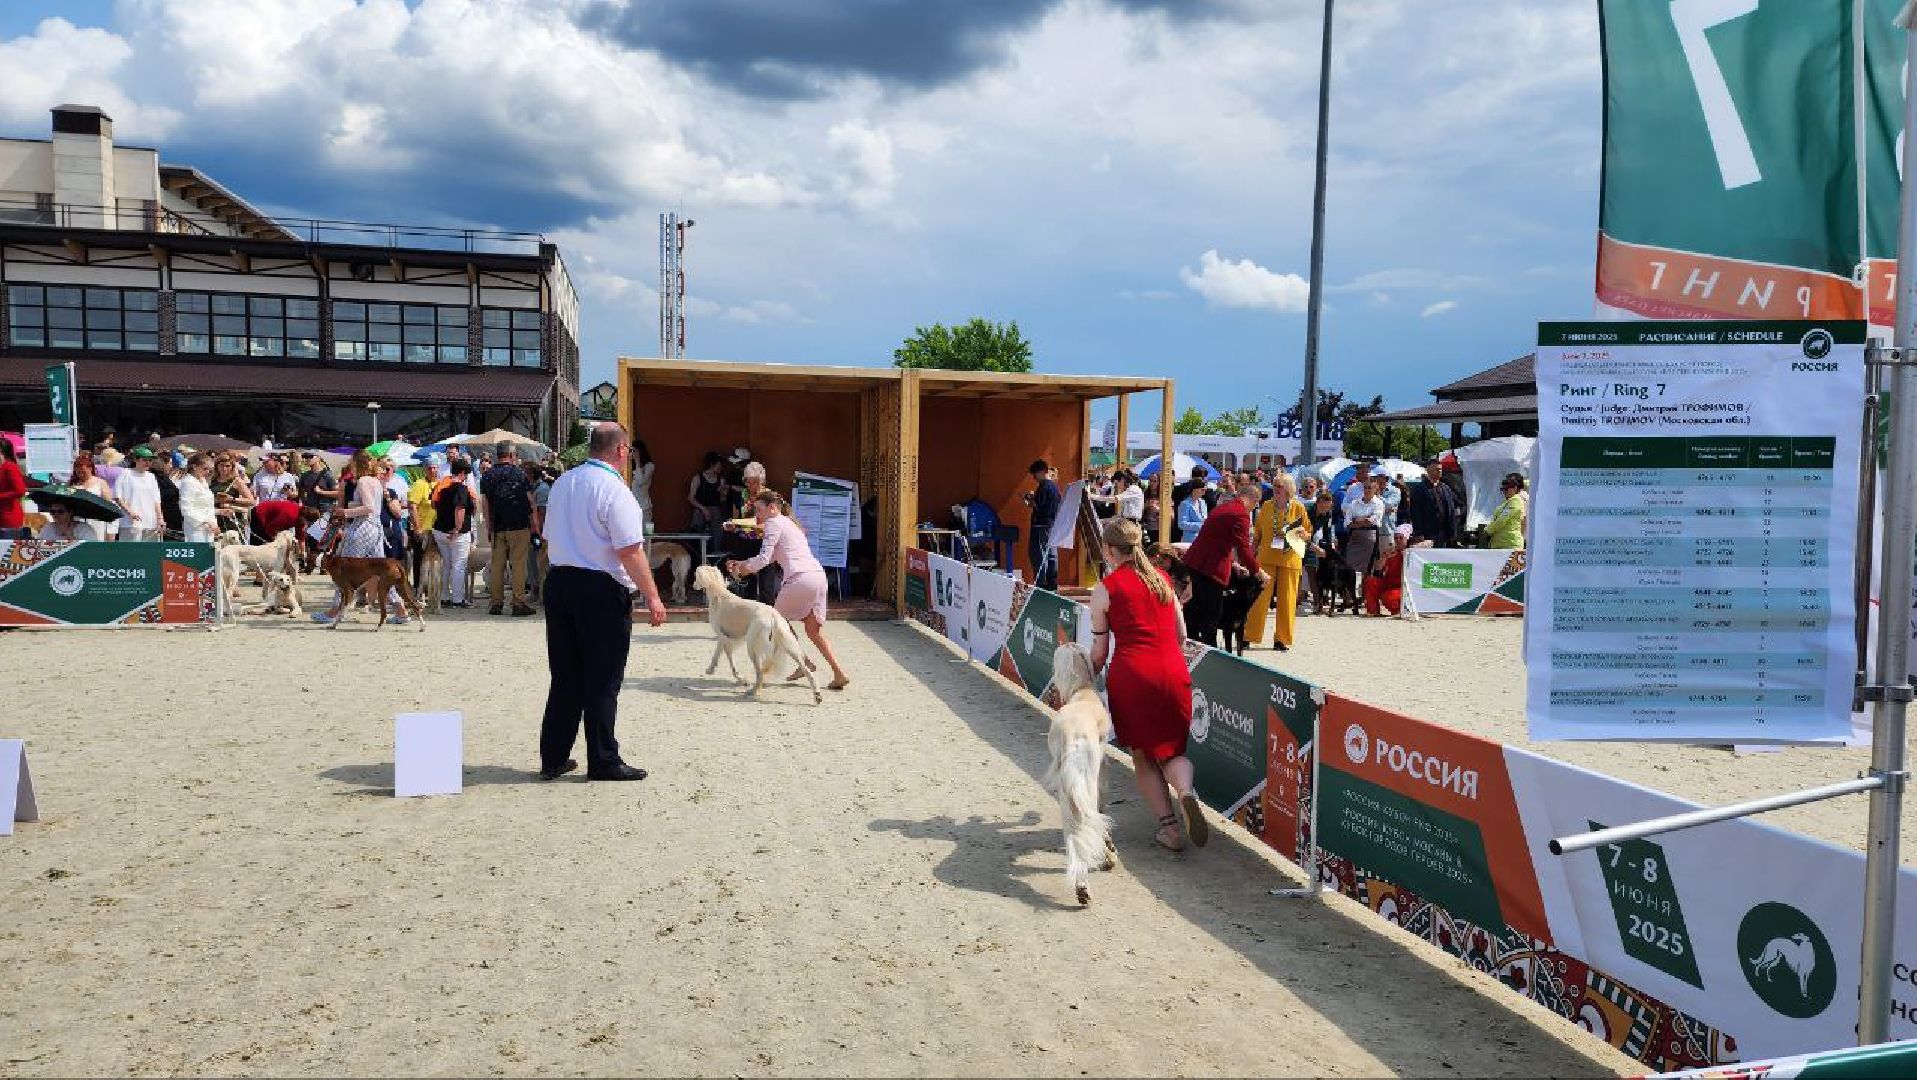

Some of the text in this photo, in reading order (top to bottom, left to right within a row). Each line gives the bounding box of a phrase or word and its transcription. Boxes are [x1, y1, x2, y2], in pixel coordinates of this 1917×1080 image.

[1638, 333, 1716, 342] РАСПИСАНИЕ
[1727, 331, 1784, 341] SCHEDULE
[1791, 362, 1839, 372] РОССИЯ
[1560, 383, 1598, 396] Ринг
[1614, 383, 1649, 399] Ring
[1657, 383, 1666, 396] 7
[1681, 403, 1744, 412] ТРОФИМОВ
[165, 548, 196, 558] 2025
[87, 568, 146, 579] РОССИЯ
[1270, 683, 1297, 710] 2025
[1212, 700, 1254, 737] РОССИЯ
[1286, 743, 1296, 764] 8
[1376, 738, 1480, 800] РОССИЯ
[1607, 842, 1623, 869] 7
[1643, 857, 1659, 884] 8
[1614, 879, 1671, 918] ИЮНЯ
[1628, 913, 1685, 957] 2025
